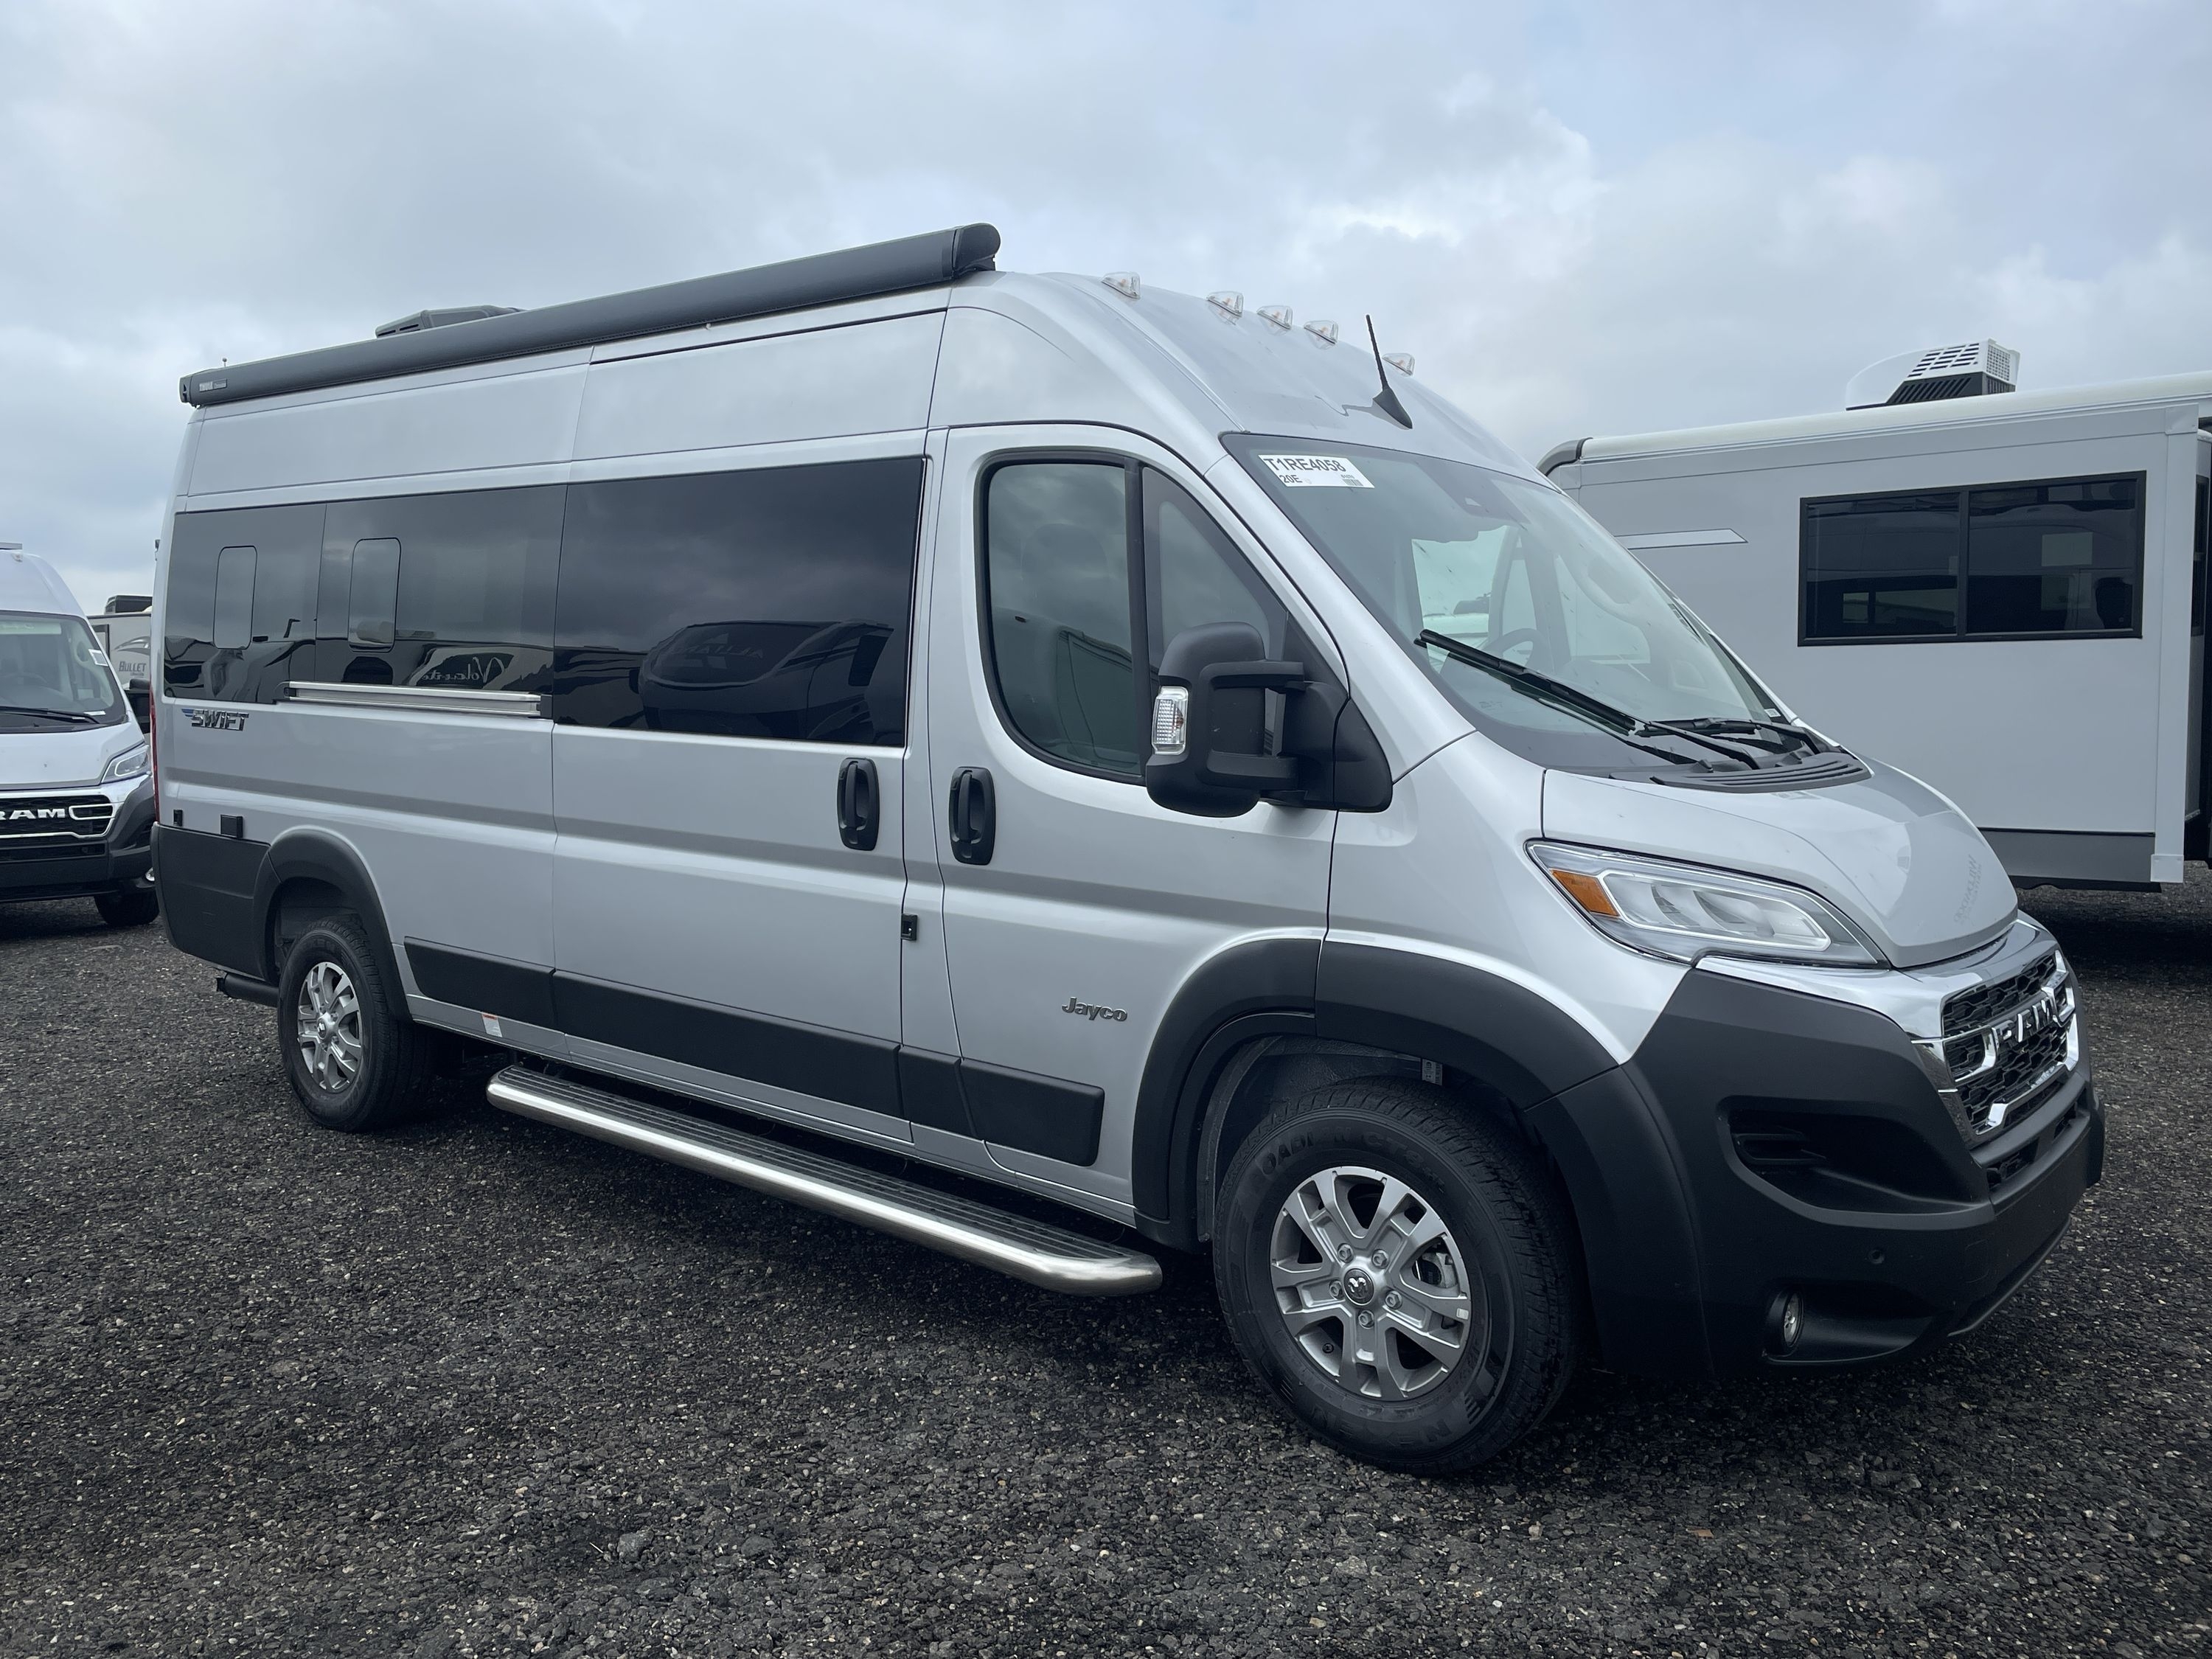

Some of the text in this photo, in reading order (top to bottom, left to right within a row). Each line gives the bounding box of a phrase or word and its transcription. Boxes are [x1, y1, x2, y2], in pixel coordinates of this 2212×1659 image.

[1263, 458, 1347, 472] T1RE4058
[1279, 474, 1303, 484] 20E
[119, 661, 147, 672] BULLET
[191, 709, 249, 731] SWIFT
[0, 808, 66, 820] AM
[1062, 996, 1128, 1022] Jayco
[1992, 997, 2050, 1050] RAM
